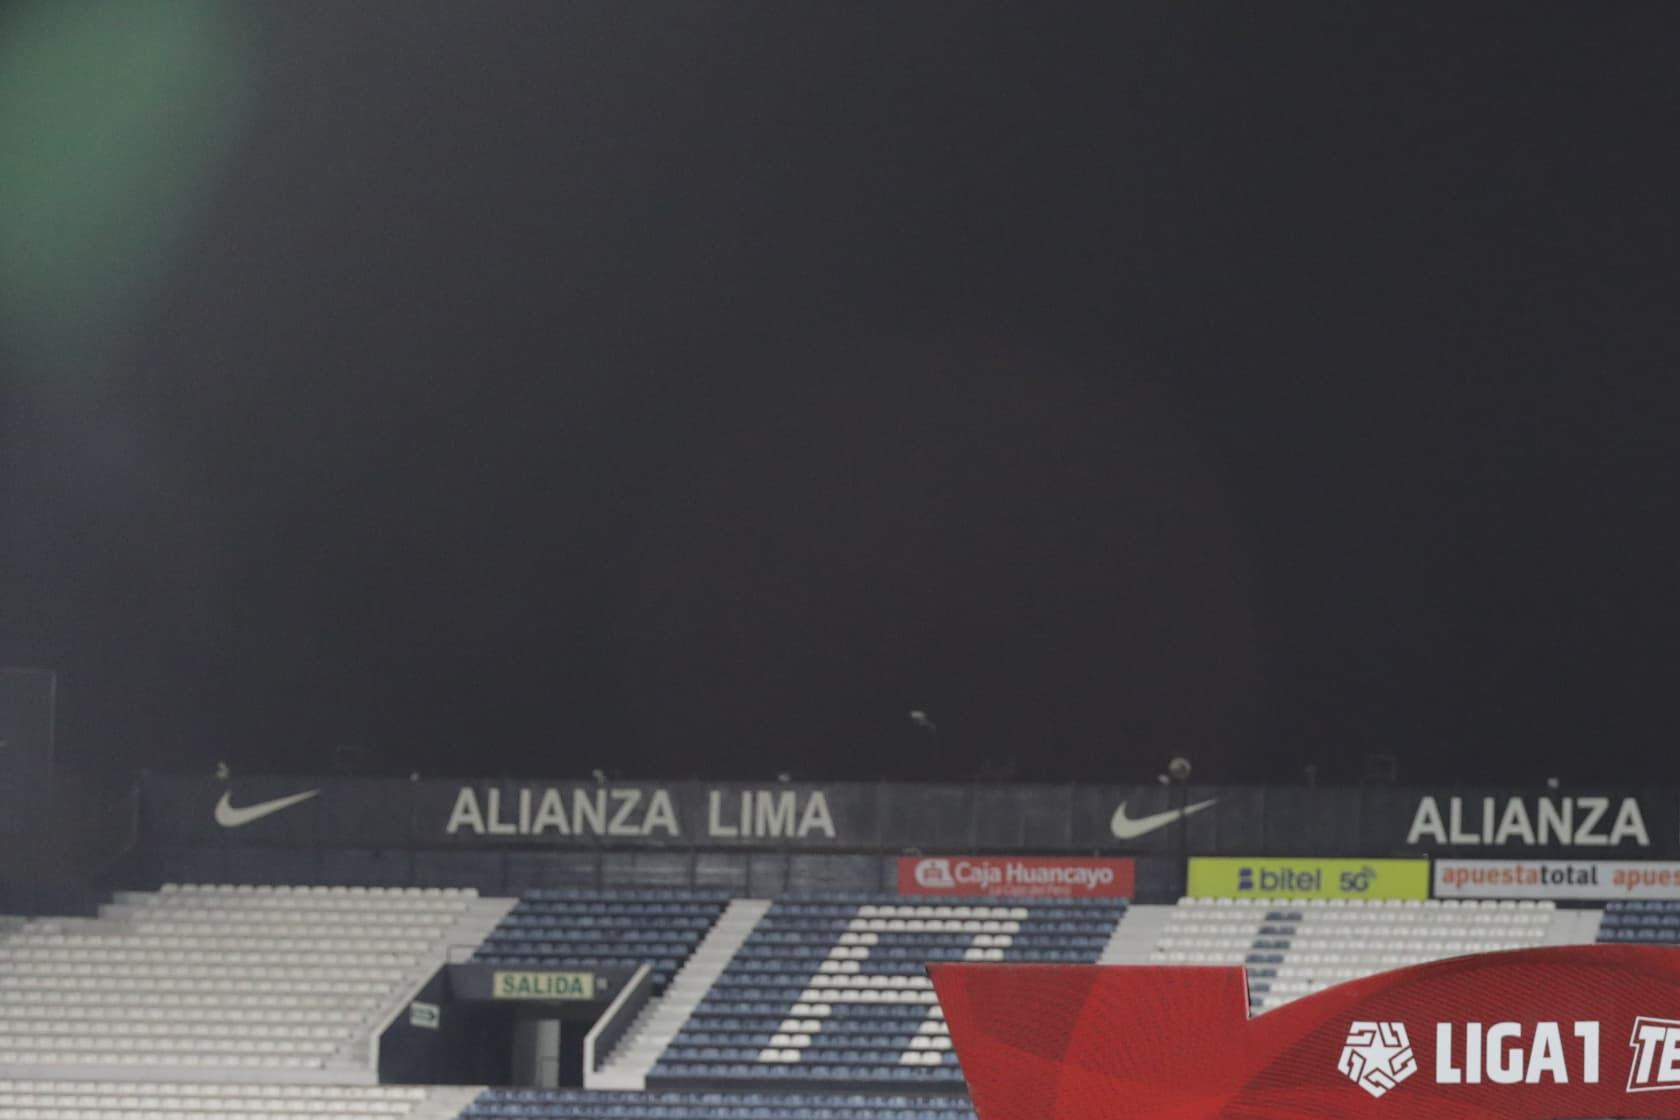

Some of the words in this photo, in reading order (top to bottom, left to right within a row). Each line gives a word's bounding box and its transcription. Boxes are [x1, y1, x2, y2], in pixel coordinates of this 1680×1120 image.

[447, 788, 679, 836] ALIANZA
[708, 790, 836, 838] LIMA
[1407, 798, 1650, 846] ALIANZA
[954, 861, 1001, 889] Caja
[1006, 863, 1114, 891] Huancayo
[1259, 865, 1321, 890] bitel
[1441, 865, 1599, 893] apuestatotal
[503, 975, 584, 995] SALIDA
